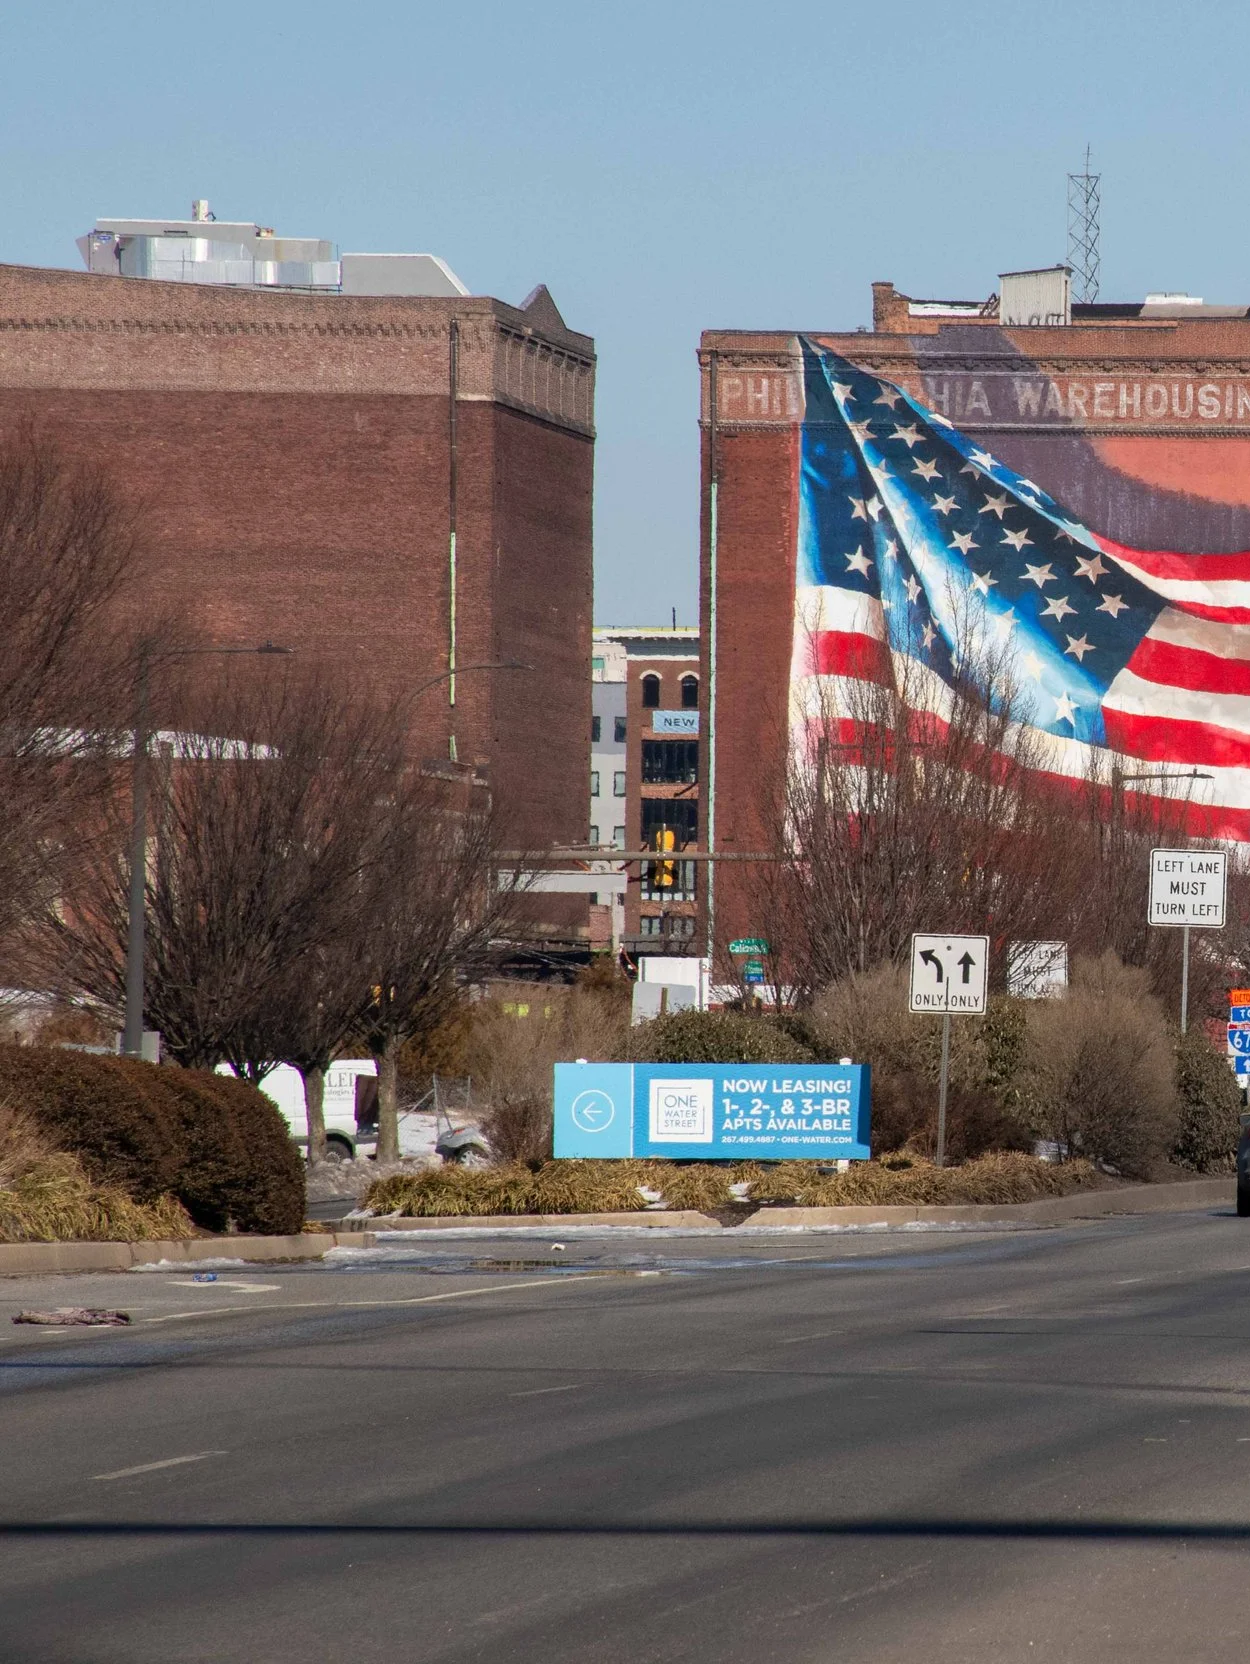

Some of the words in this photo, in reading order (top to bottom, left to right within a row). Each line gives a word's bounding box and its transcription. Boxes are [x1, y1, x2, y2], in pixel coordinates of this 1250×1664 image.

[664, 717, 695, 726] NEW
[1157, 860, 1184, 872] LEFT
[1190, 862, 1220, 873] LANE
[1170, 881, 1207, 895] MUST
[1155, 902, 1186, 915] TURN
[1192, 904, 1219, 916] LEFT
[915, 994, 943, 1006] ONLY
[951, 995, 981, 1007] ONLY
[722, 1080, 768, 1093] NOW
[772, 1080, 851, 1093] LEASING!
[664, 1095, 698, 1108] ONE
[722, 1099, 744, 1117] 1-,
[750, 1099, 775, 1117] 2-,
[781, 1099, 795, 1115] &
[801, 1099, 850, 1115] 3-BR
[664, 1110, 698, 1118] WATER
[664, 1120, 697, 1128] STREET
[722, 1119, 762, 1131] APTS
[766, 1118, 852, 1131] AVAILABLE
[781, 1136, 852, 1144] ONE-WATER.COM
